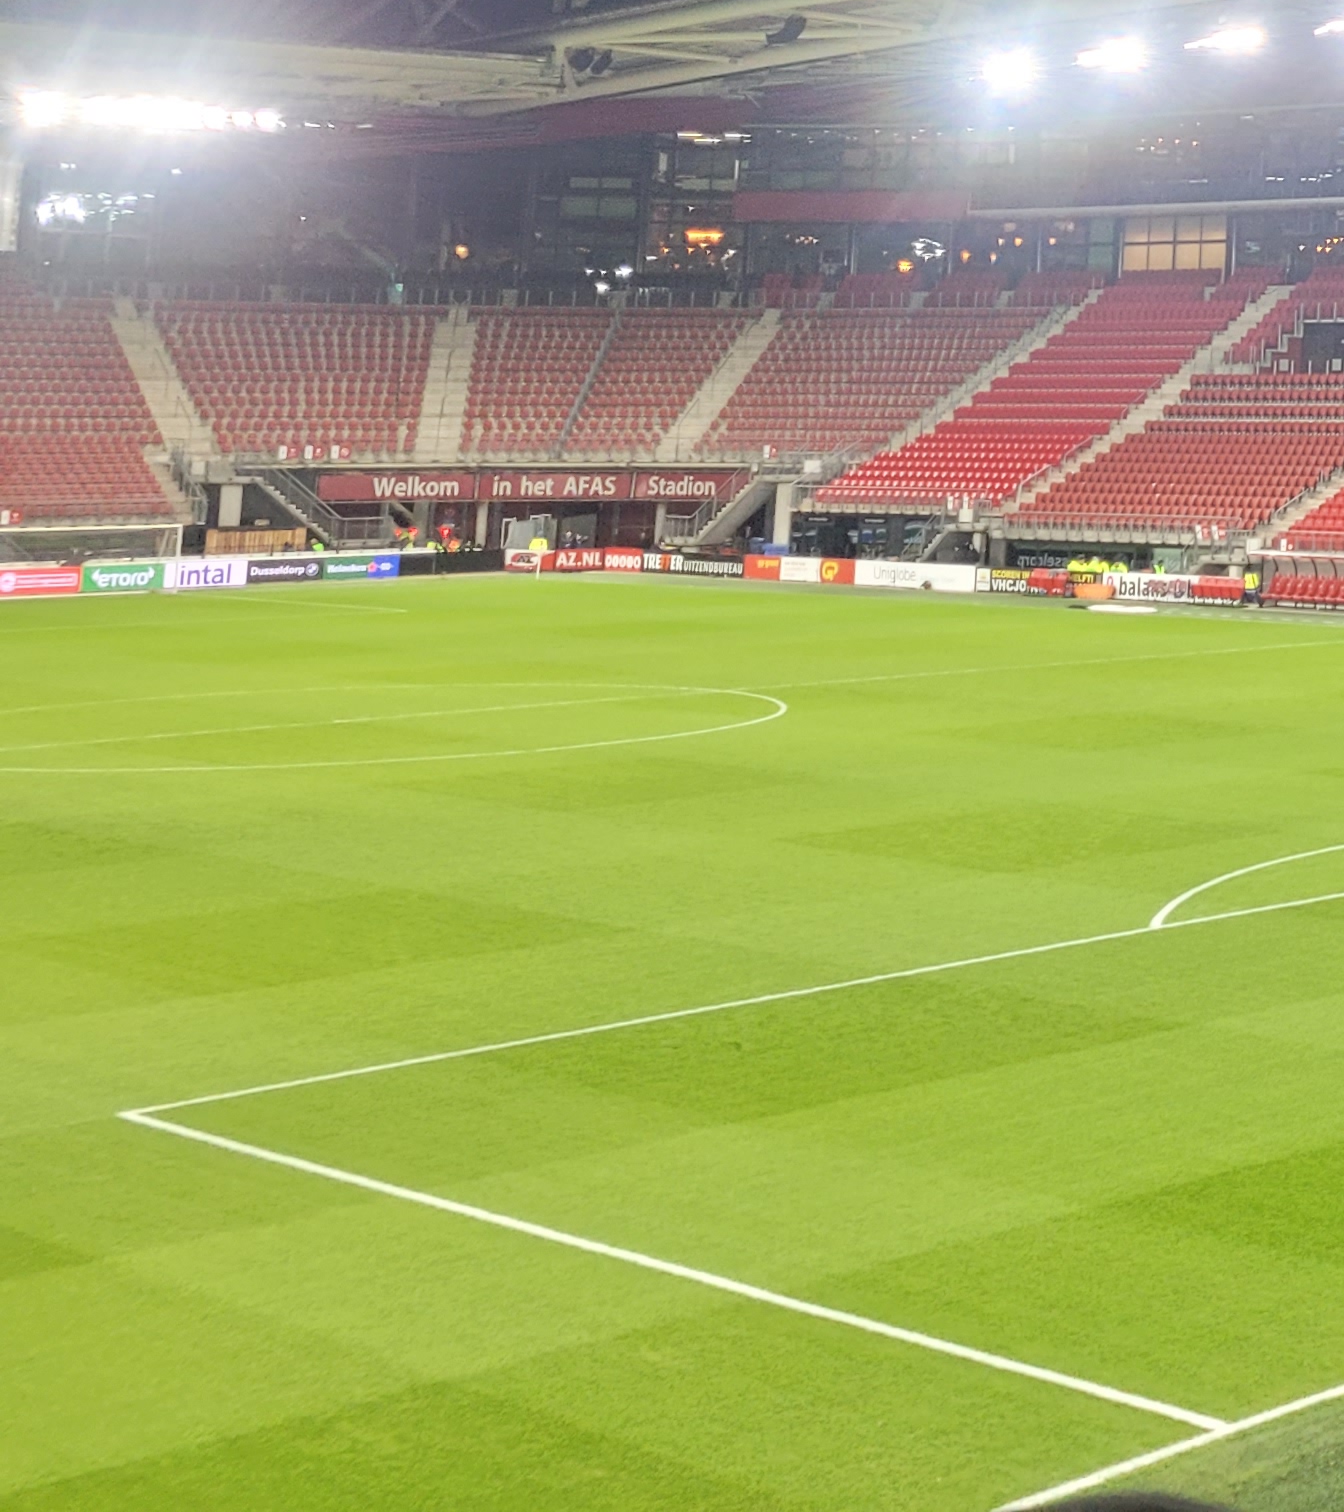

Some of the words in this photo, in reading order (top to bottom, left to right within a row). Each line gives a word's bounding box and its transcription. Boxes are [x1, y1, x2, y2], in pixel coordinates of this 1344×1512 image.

[373, 476, 459, 498] Welkom
[492, 475, 512, 497] in
[521, 475, 553, 496] het
[563, 475, 617, 496] AFAS
[647, 475, 716, 496] Stadion
[555, 551, 602, 568] AZ.NL
[179, 563, 232, 587] intal
[249, 564, 306, 578] Dusseldorp
